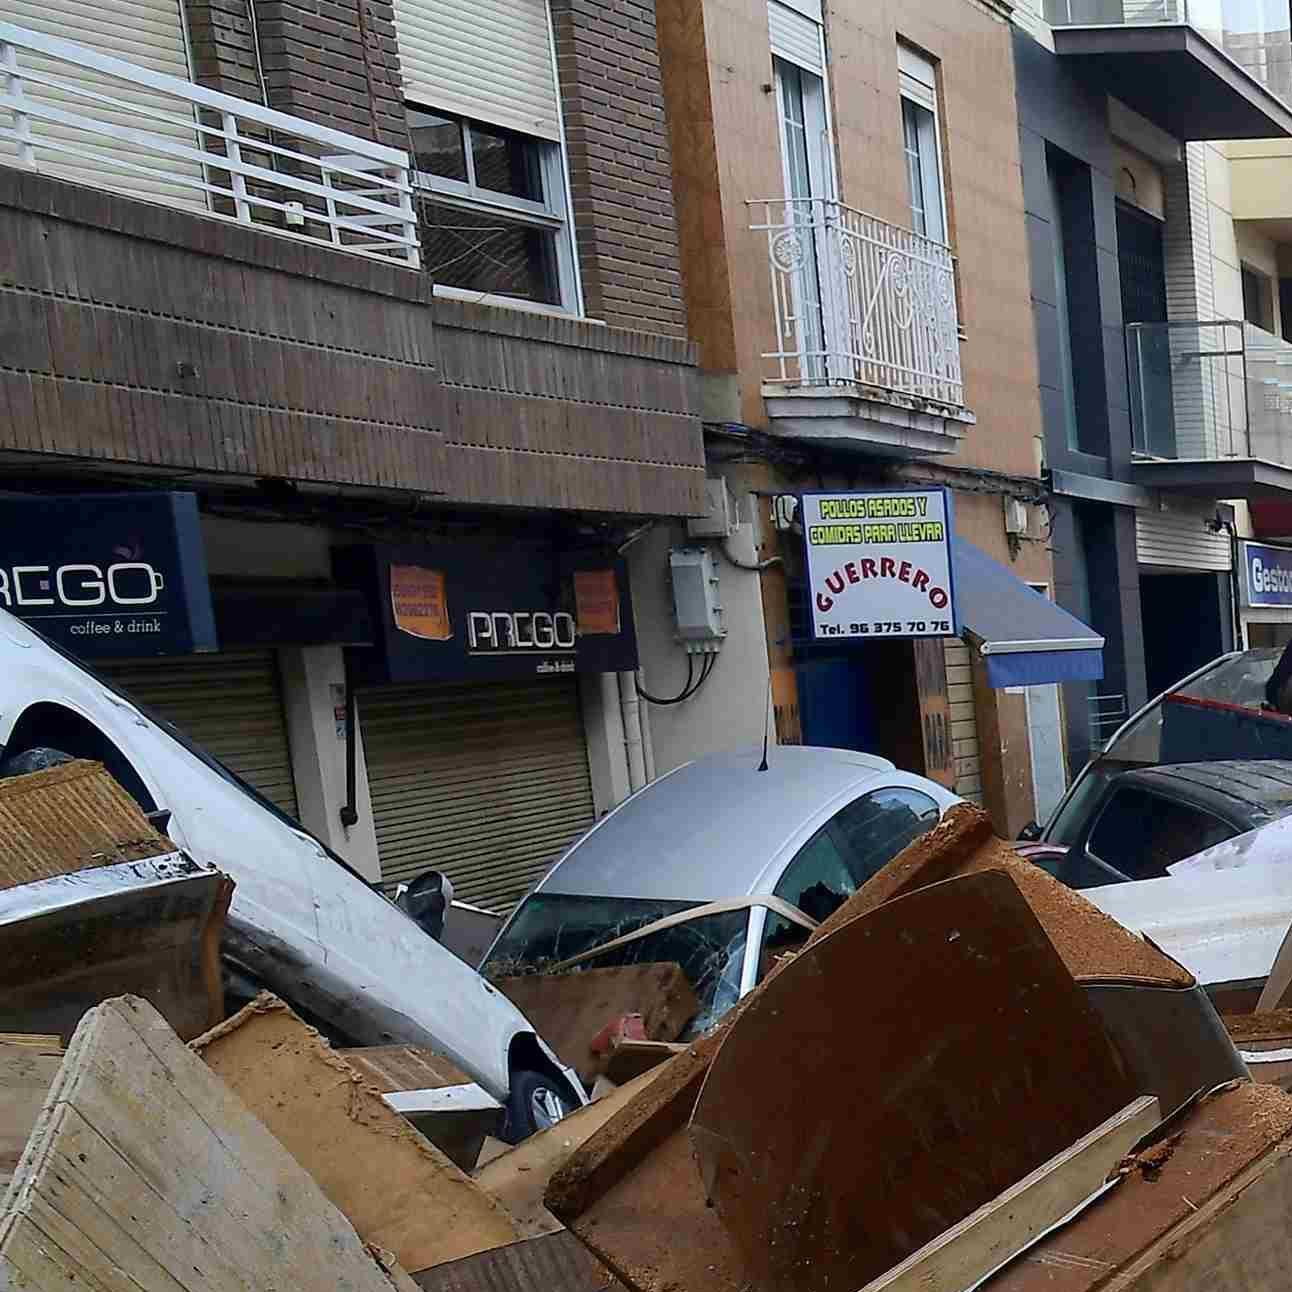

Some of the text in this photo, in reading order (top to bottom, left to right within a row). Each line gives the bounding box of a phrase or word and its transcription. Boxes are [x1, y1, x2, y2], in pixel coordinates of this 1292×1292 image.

[820, 496, 927, 519] POLLOS ASADOS Y
[809, 522, 944, 545] COMIDAS PARA LLEVAR
[816, 557, 948, 612] GUERRERO
[70, 618, 161, 634] coffee & drink
[467, 612, 576, 648] PREGO
[820, 620, 950, 635] Tel. 96 375 70 76
